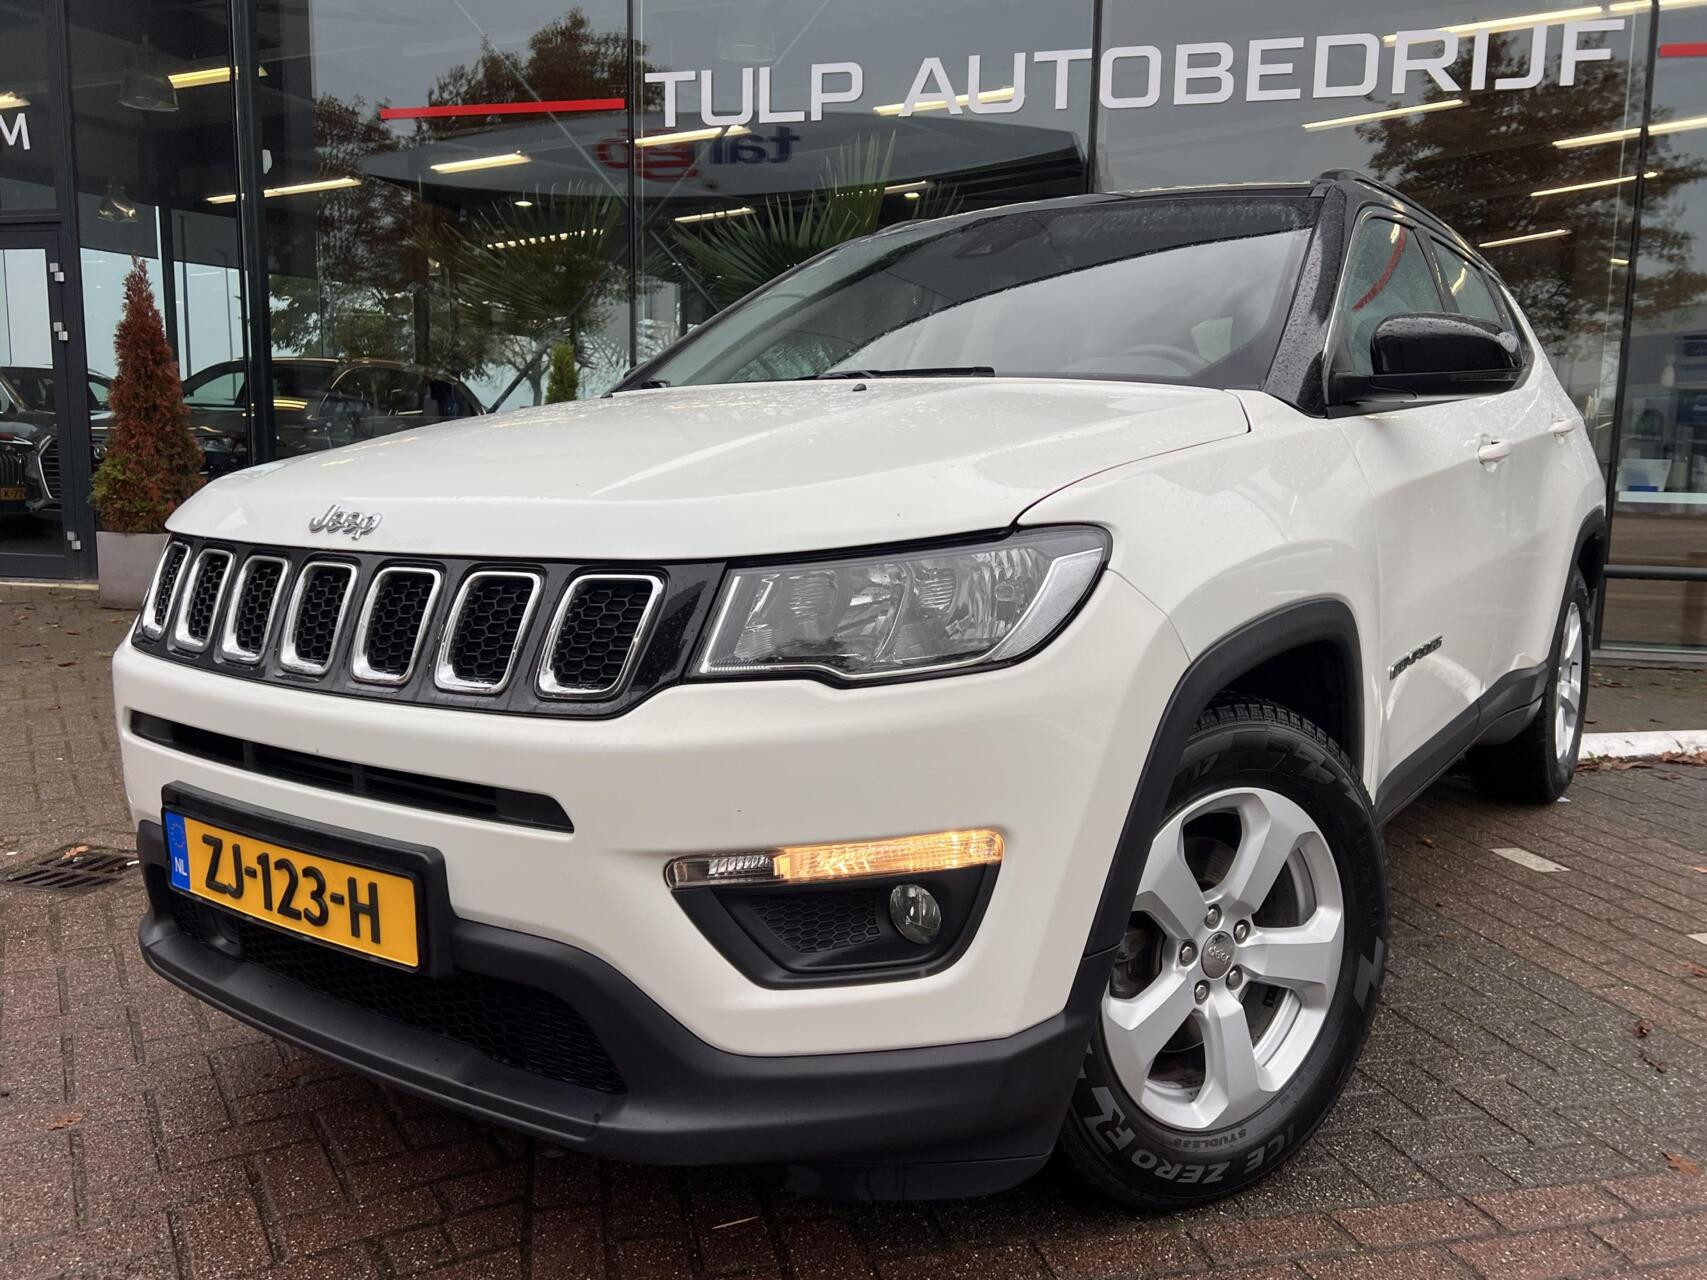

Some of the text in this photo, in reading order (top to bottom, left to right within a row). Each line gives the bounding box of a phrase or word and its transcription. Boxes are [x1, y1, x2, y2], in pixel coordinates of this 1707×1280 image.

[645, 18, 1625, 128] TULP AUTOBEDRIJF
[308, 504, 382, 541] Jeep
[174, 856, 188, 876] NL
[202, 833, 381, 945] ZJ-123-H
[1173, 1128, 1247, 1150] STUDLESS
[1244, 1121, 1295, 1174] ICE
[1131, 1149, 1231, 1185] ZERO
